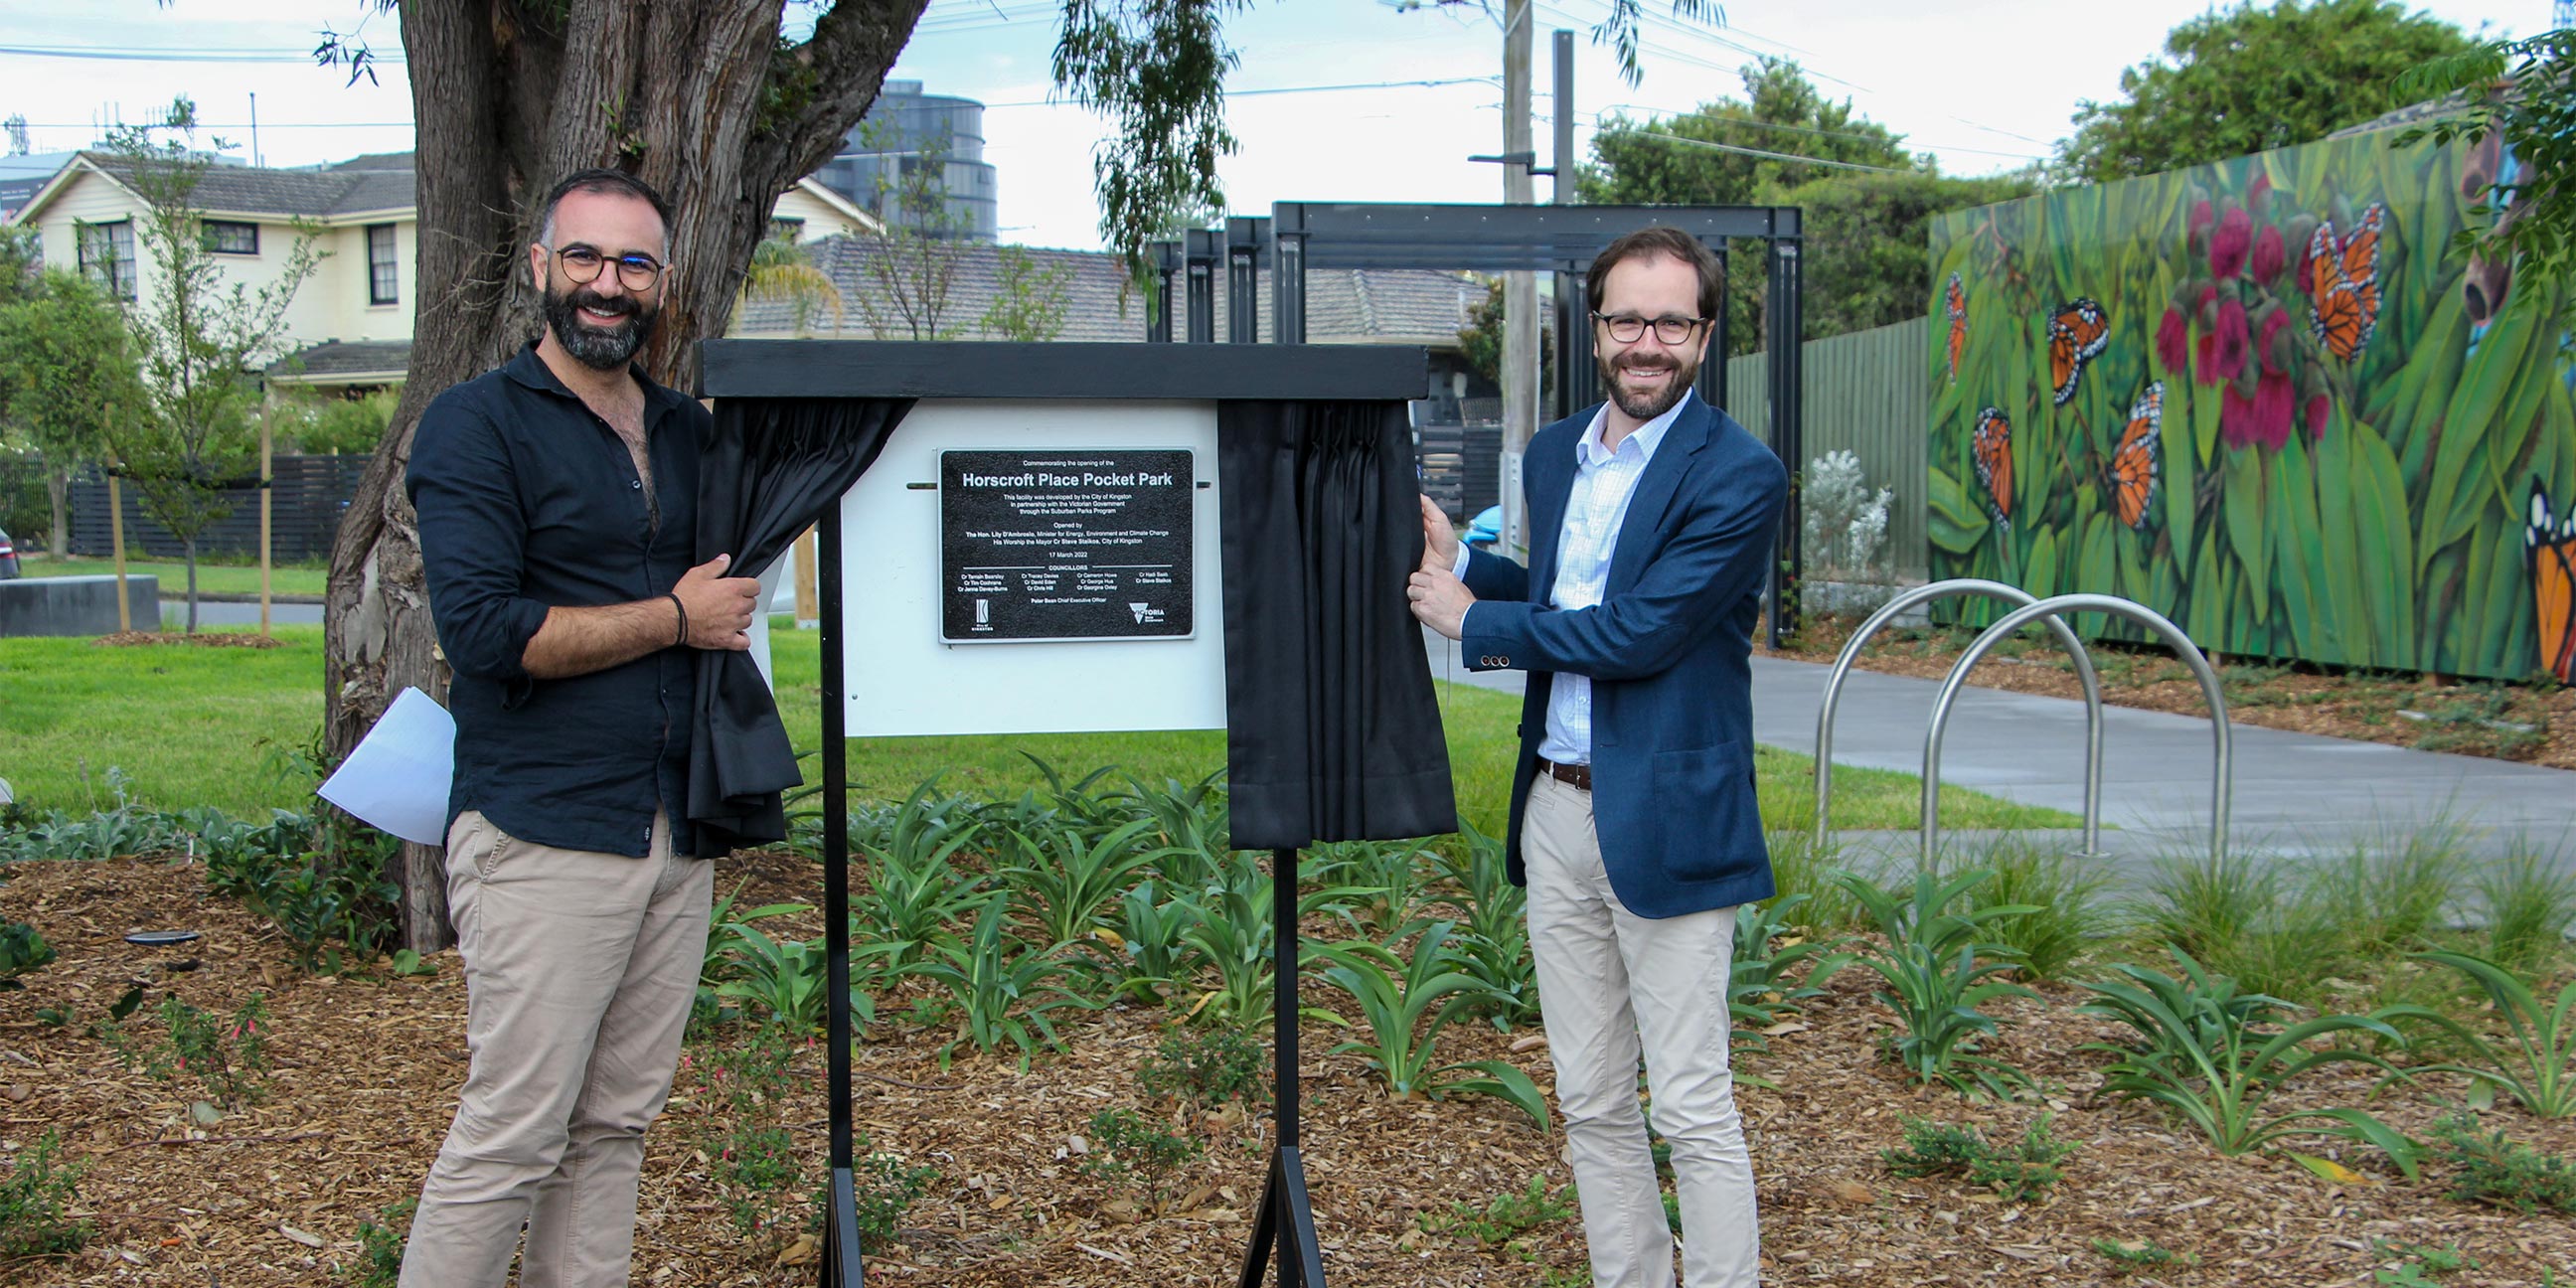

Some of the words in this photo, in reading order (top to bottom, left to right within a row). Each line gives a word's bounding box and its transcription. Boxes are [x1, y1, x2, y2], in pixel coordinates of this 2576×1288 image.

[962, 473, 1035, 487] Horscroft
[1039, 473, 1079, 487] Place
[1083, 472, 1135, 486] Pocket
[1139, 472, 1173, 486] Park
